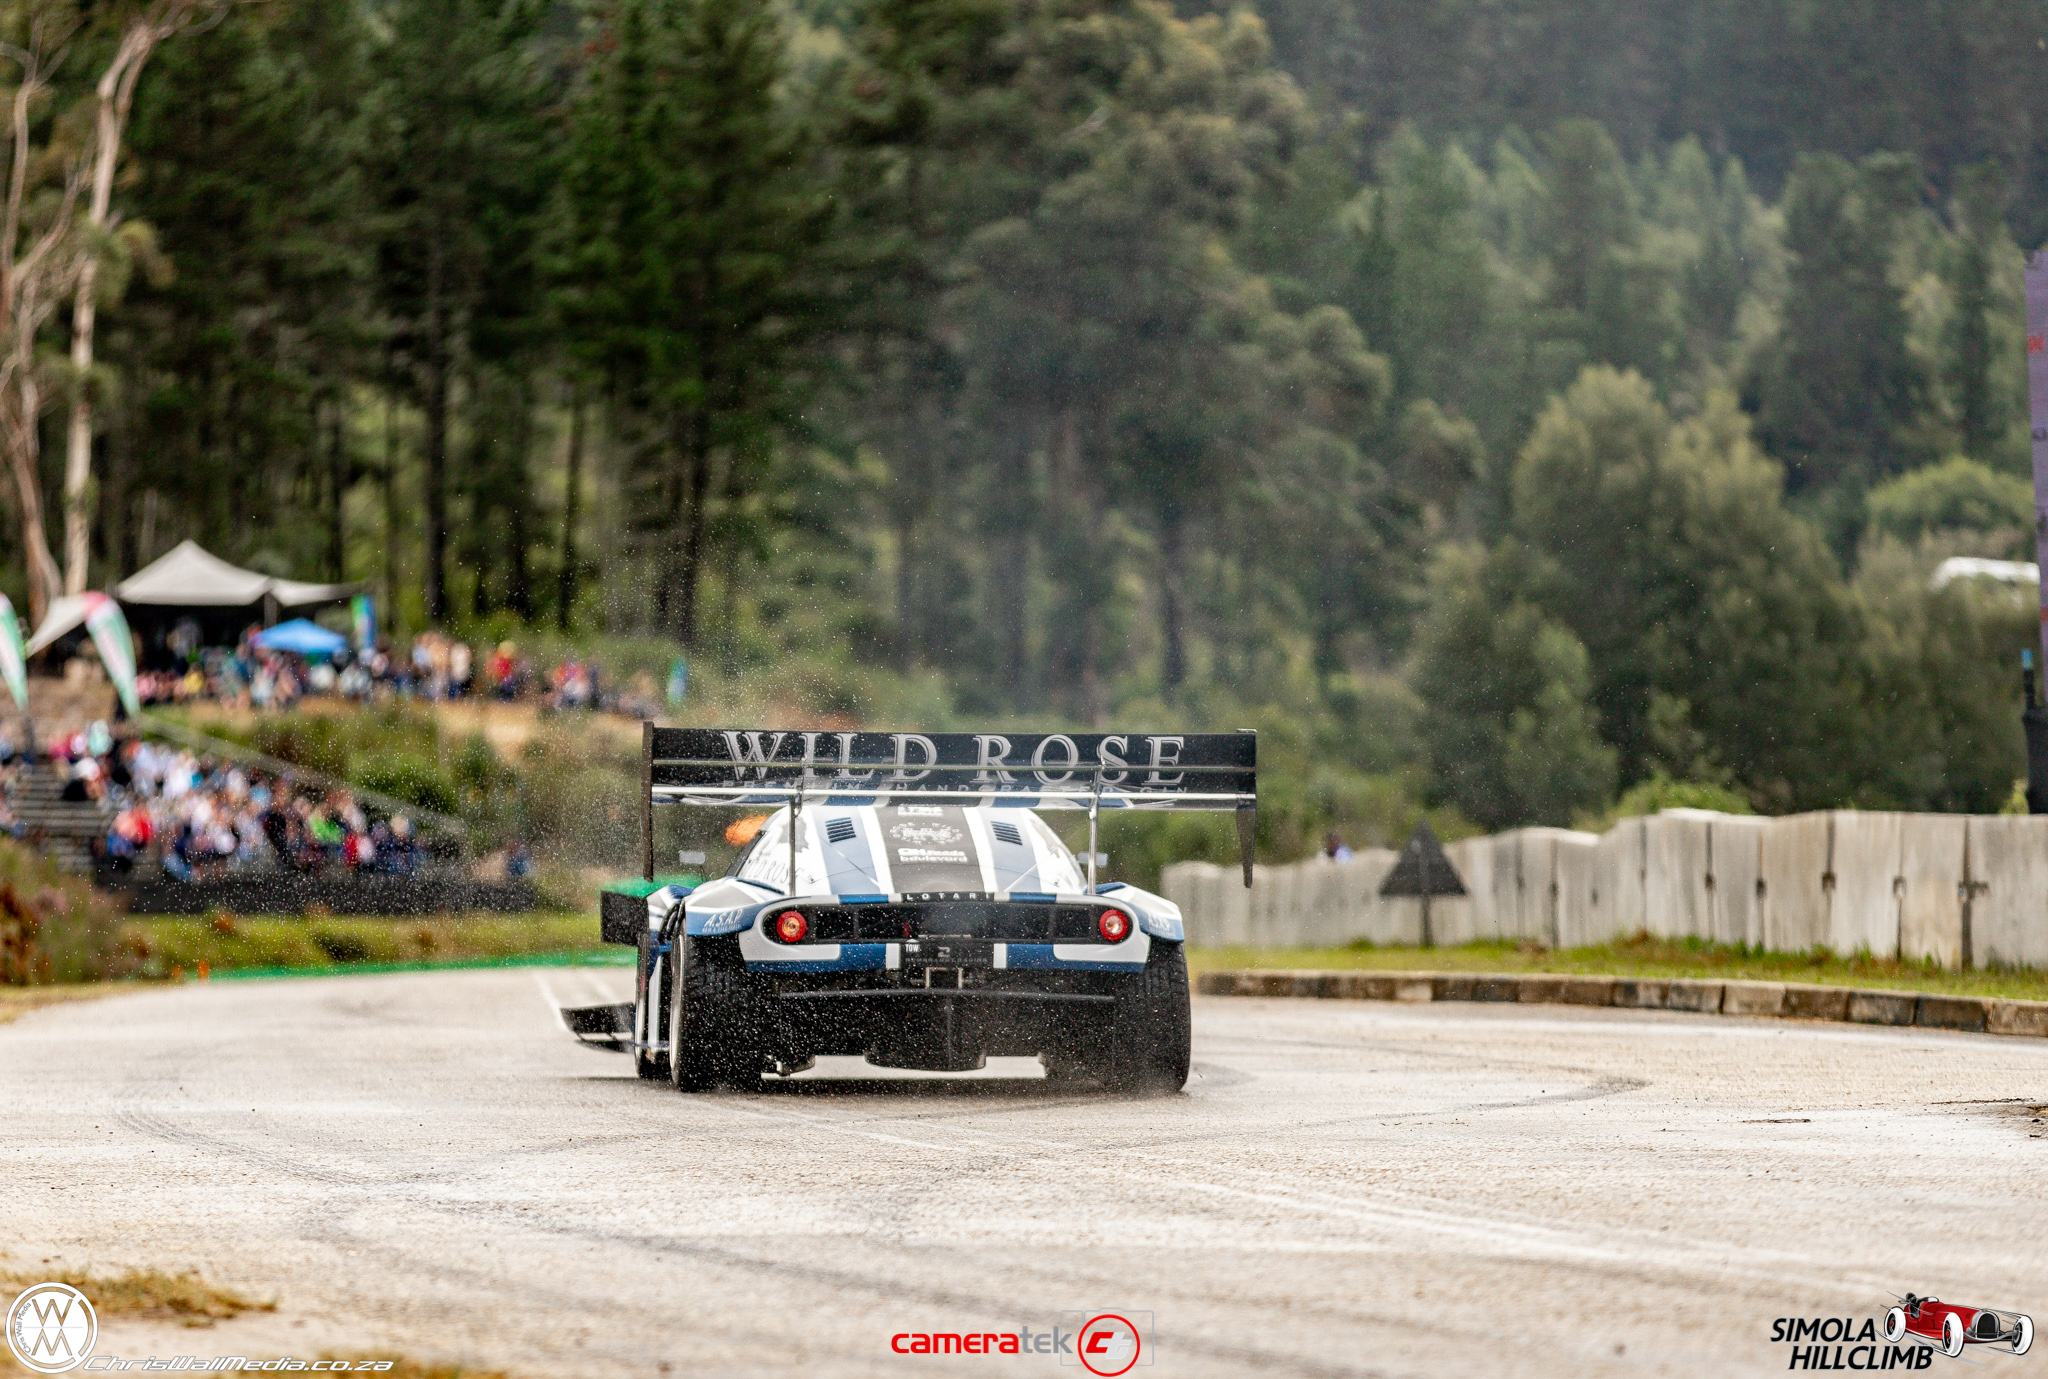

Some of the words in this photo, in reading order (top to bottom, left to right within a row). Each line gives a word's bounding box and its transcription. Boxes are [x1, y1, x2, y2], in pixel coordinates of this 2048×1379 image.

[721, 731, 937, 781] WILD
[972, 735, 1185, 785] ROSE
[906, 892, 990, 901] LOTARI
[904, 943, 919, 953] TOW
